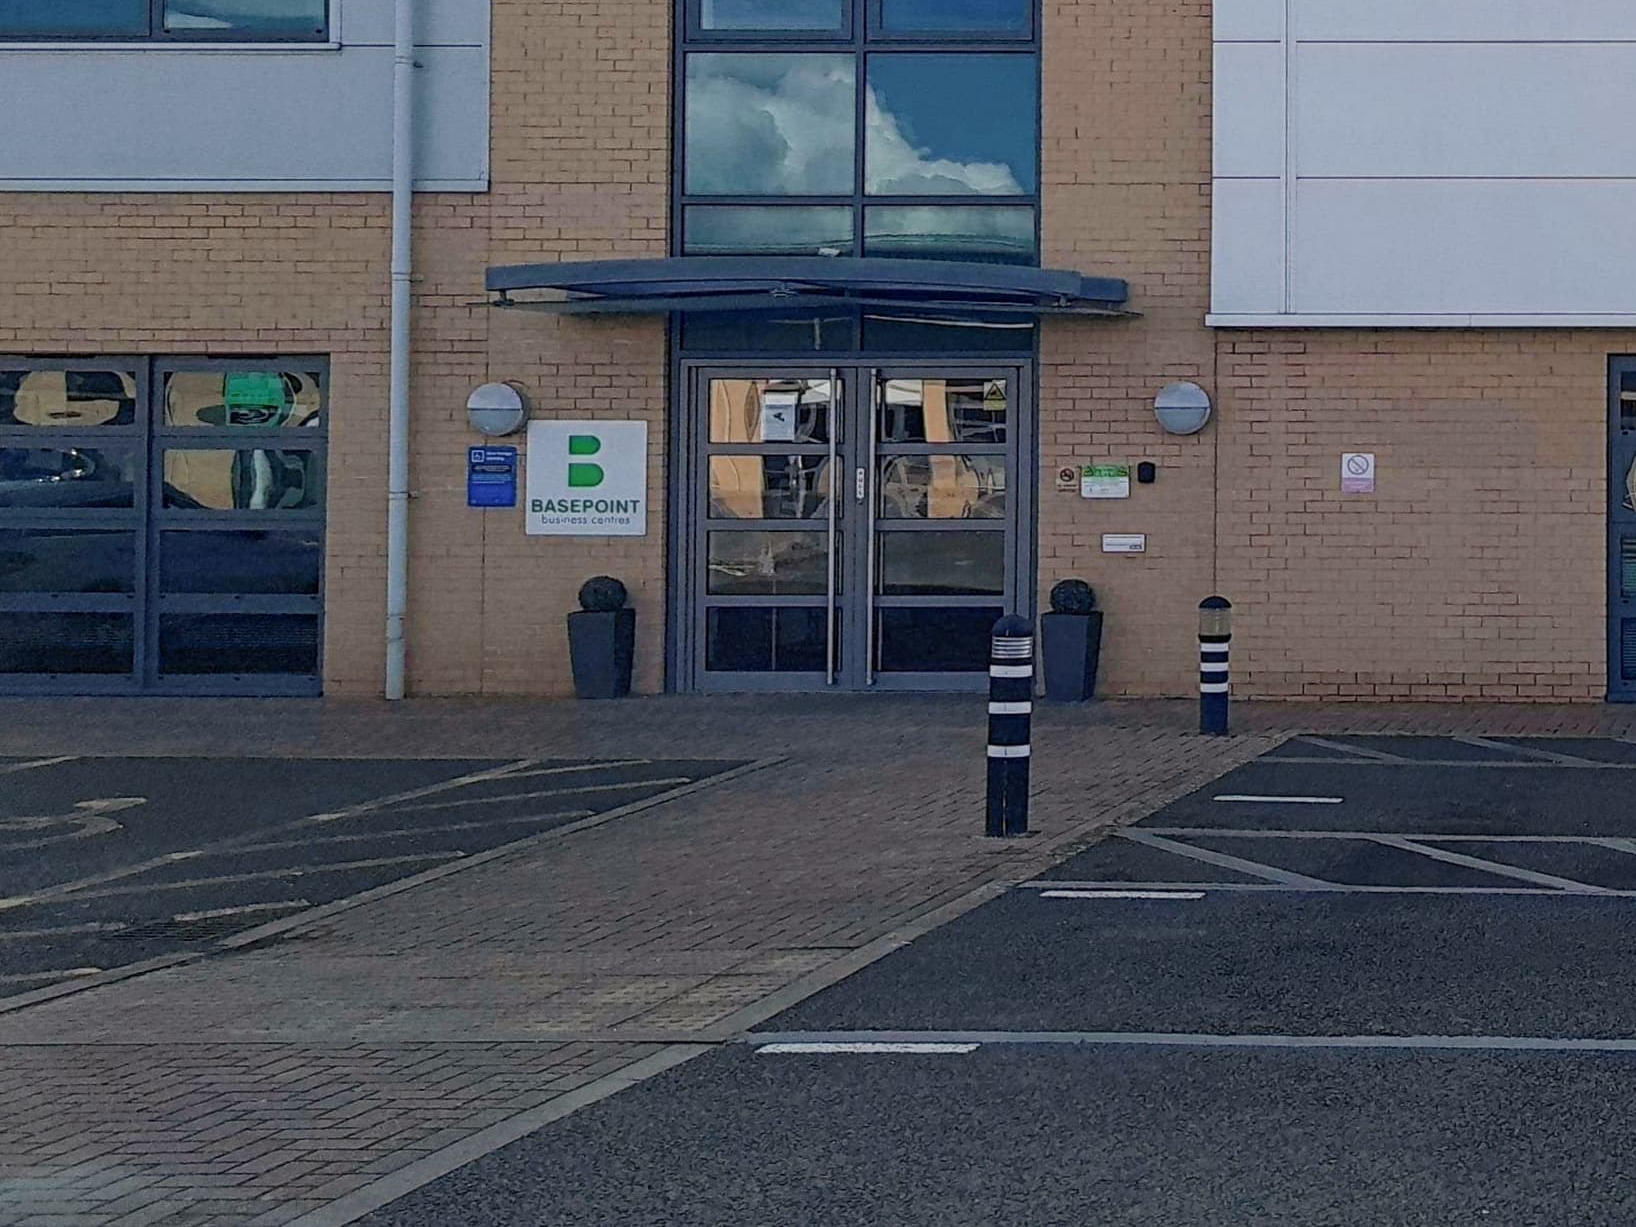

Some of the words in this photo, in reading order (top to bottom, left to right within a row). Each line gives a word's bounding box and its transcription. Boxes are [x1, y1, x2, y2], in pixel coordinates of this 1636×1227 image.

[531, 499, 640, 513] BASEPOINT
[541, 514, 587, 524] business
[591, 516, 630, 524] centres
